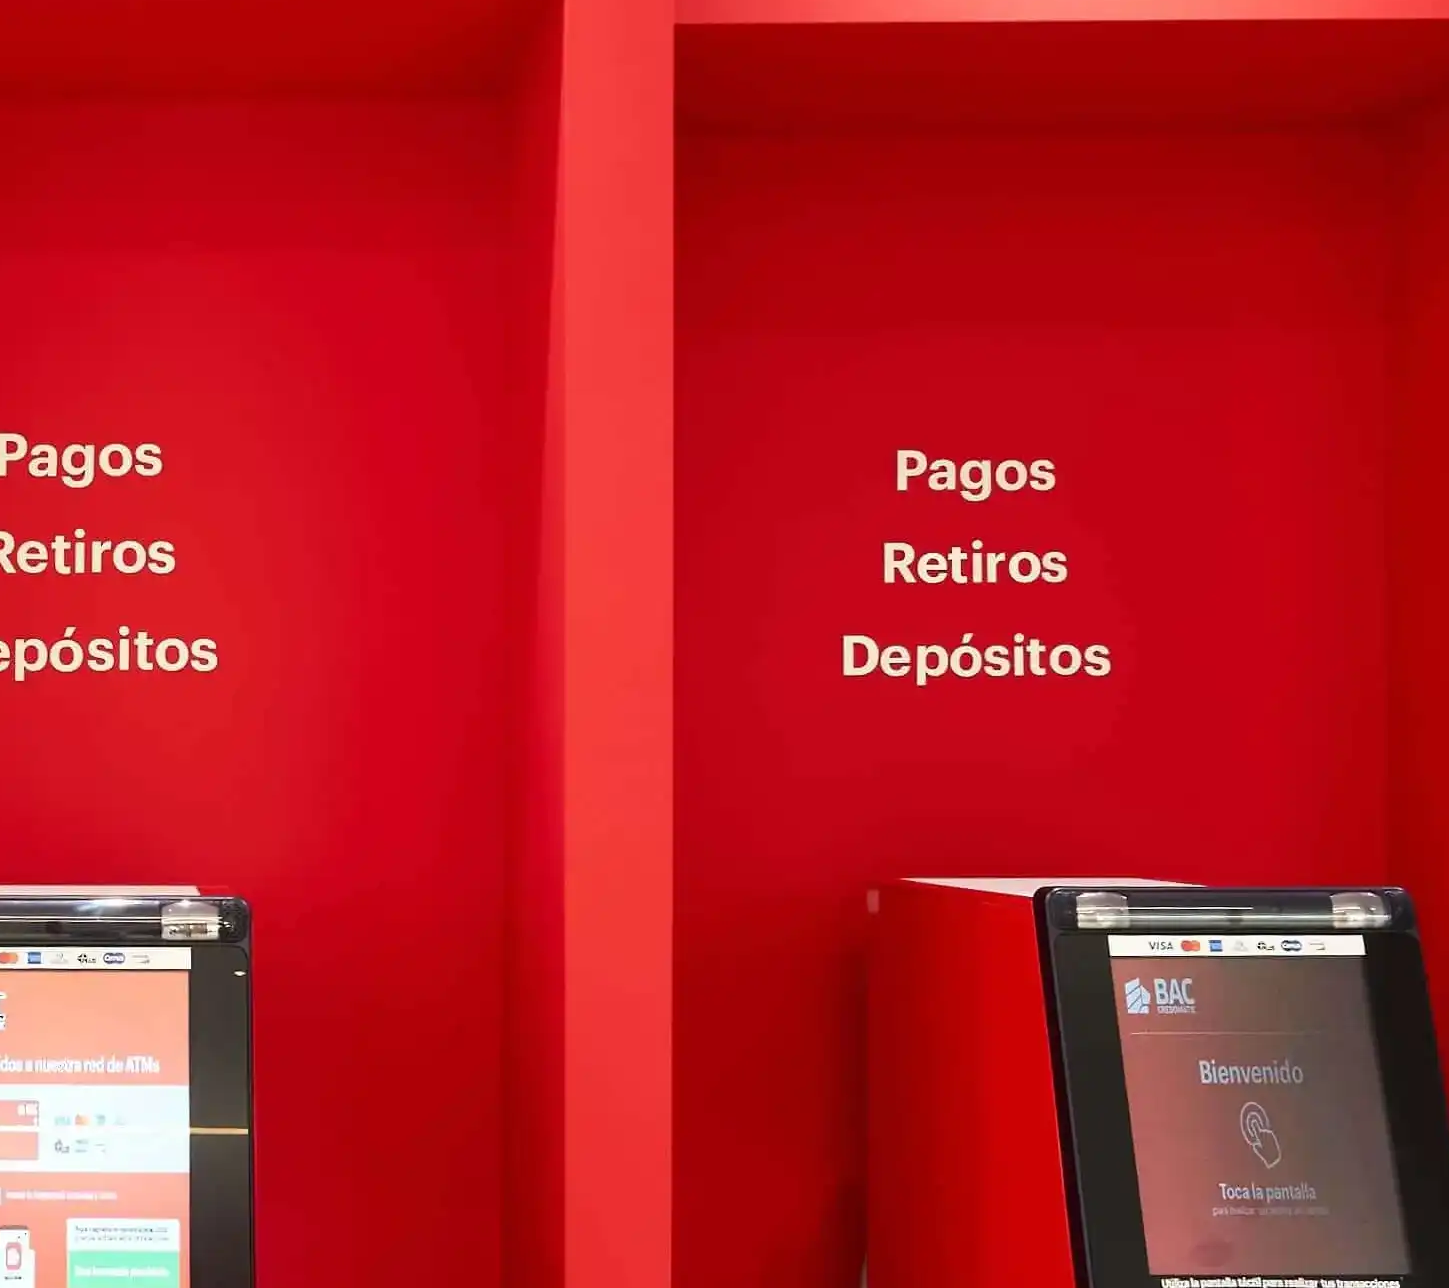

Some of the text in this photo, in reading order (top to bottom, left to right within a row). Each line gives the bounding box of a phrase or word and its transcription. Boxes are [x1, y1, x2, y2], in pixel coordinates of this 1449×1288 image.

[896, 449, 1056, 502] Pagos
[882, 539, 1068, 584] Retiros
[842, 632, 1112, 686] Depósitos
[1148, 941, 1174, 951] VISA
[1154, 978, 1196, 1005] BAC
[1198, 1059, 1303, 1085] Bienvenido
[1218, 1182, 1317, 1204] Toca la pantalla
